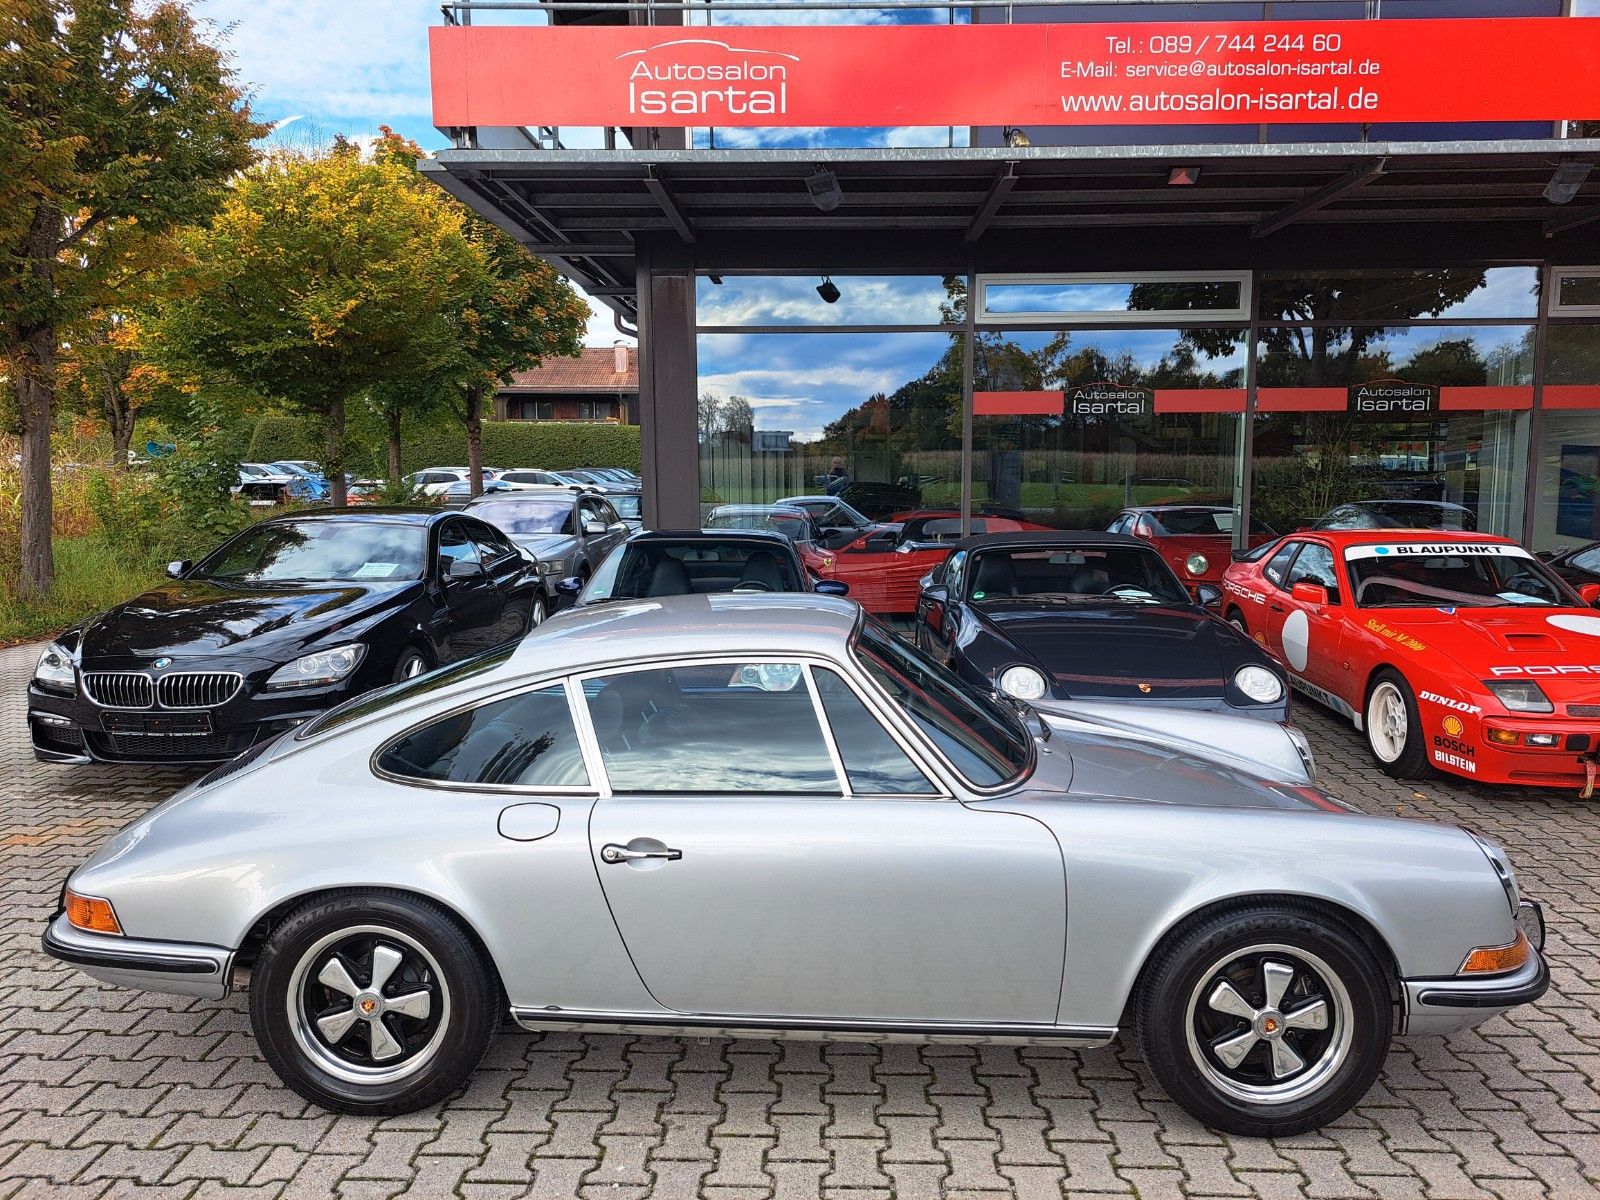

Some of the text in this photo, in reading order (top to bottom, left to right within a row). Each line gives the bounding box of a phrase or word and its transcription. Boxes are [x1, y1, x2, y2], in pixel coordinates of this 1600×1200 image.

[1105, 36, 1143, 54] Tel.:
[1149, 35, 1192, 54] 089
[1215, 34, 1256, 53] 744
[1263, 34, 1305, 52] 244
[1312, 33, 1342, 51] 60
[630, 60, 786, 81] Autosalon
[1061, 58, 1380, 78] E-Mail: service@autosalon-isartal.de
[629, 81, 786, 114] Isartal
[1061, 87, 1378, 112] www.autosalon-isartal.de
[1073, 390, 1145, 400] Autosalon
[1358, 387, 1431, 397] Autosalon
[1073, 399, 1145, 414] Isartal
[1357, 396, 1430, 411] Isartal
[1396, 546, 1502, 554] BLAUPUNKT
[1364, 618, 1387, 633] Shell
[1419, 690, 1482, 714] DUNLOP
[1434, 735, 1475, 757] BOSCH
[1434, 749, 1476, 773] BILSTEIN
